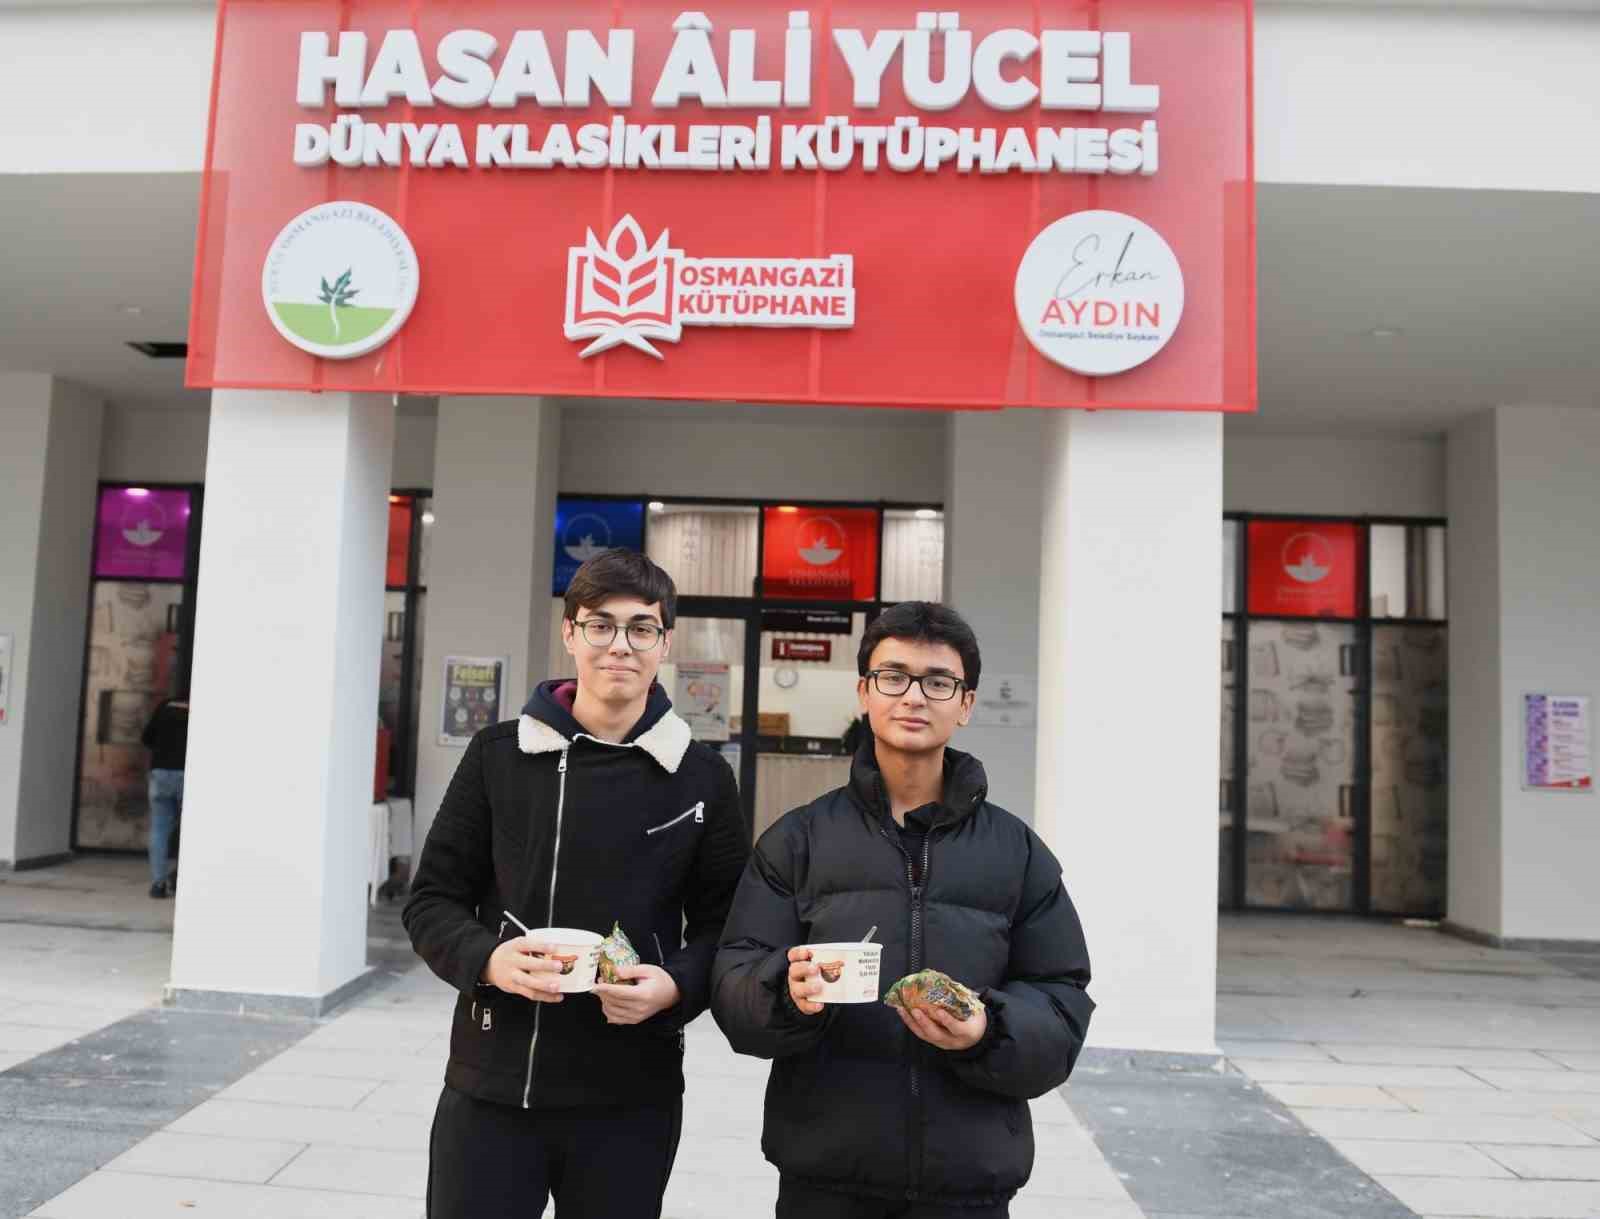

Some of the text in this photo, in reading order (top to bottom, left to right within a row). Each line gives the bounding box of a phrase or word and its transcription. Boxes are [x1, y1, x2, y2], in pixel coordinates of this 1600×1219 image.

[297, 11, 1161, 112] HASAN ÂLİ YÜCEL
[293, 114, 1159, 174] DÜNYA KLASİKLERİ KÜTÜPHANESİ
[680, 263, 844, 288] OSMANGAZİ
[1055, 231, 1160, 300] Erkan
[679, 290, 847, 317] KÜTÜPHANE
[1040, 299, 1160, 327] AYDIN
